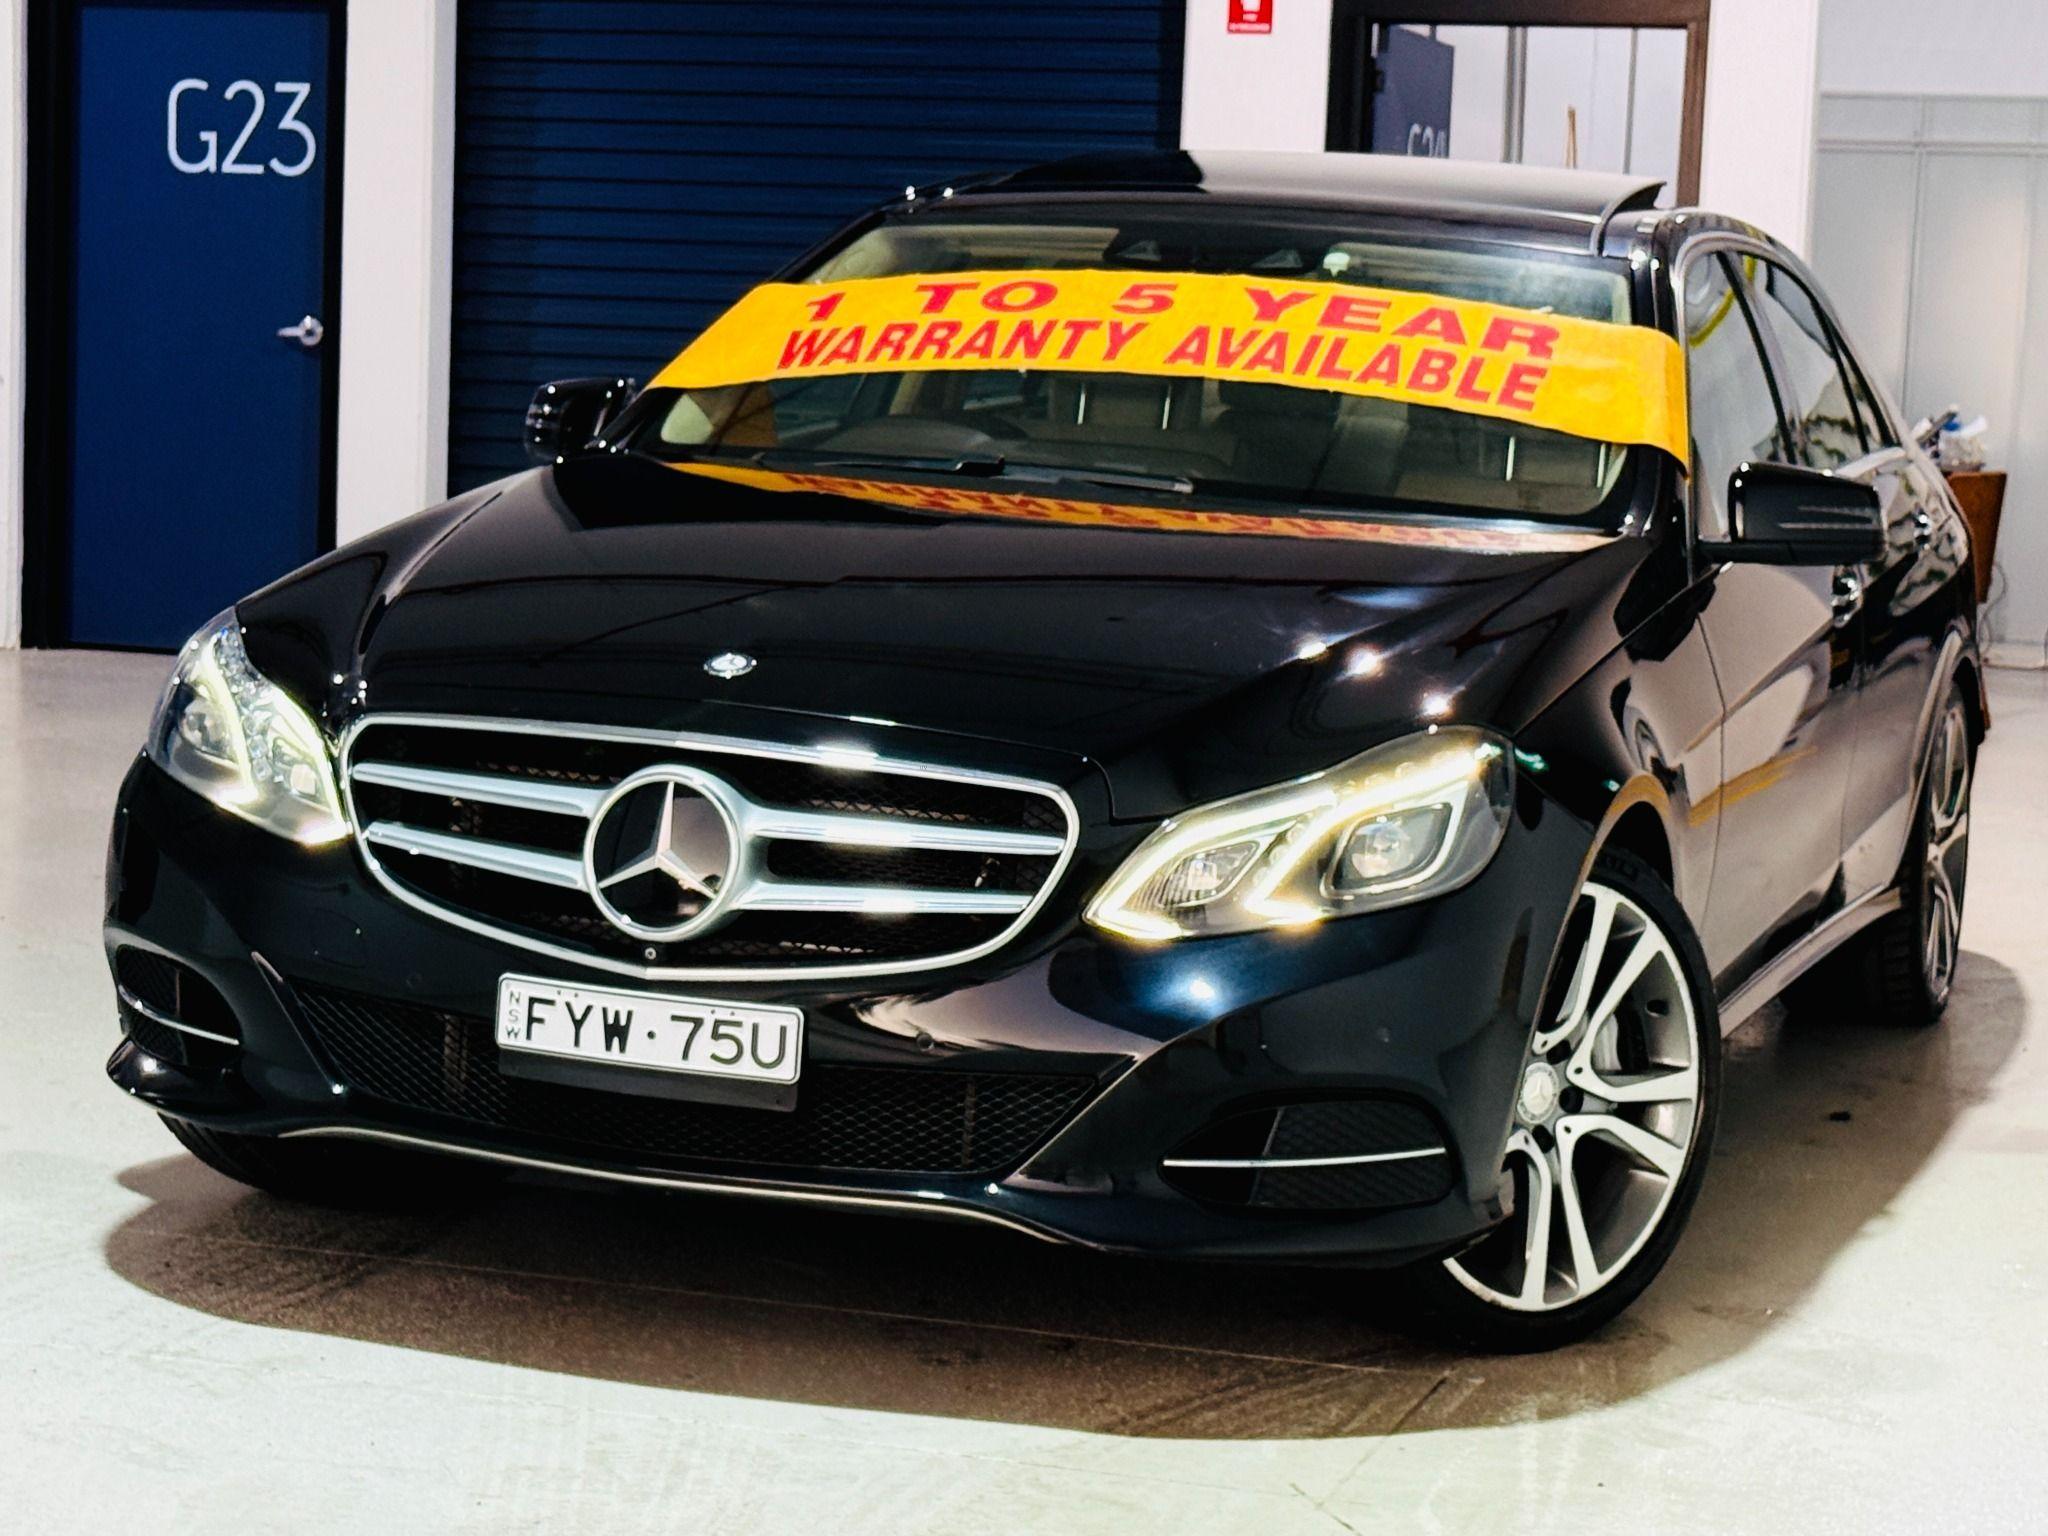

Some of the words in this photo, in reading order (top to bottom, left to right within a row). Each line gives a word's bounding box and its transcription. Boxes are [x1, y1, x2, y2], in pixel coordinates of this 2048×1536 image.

[167, 78, 317, 177] G23
[776, 319, 1150, 369] WARRANTY
[1164, 325, 1549, 412] AVAILABLE
[806, 292, 845, 321] 1
[915, 281, 1058, 314] TO
[1111, 284, 1178, 314] 5
[1244, 287, 1560, 360] YEAR
